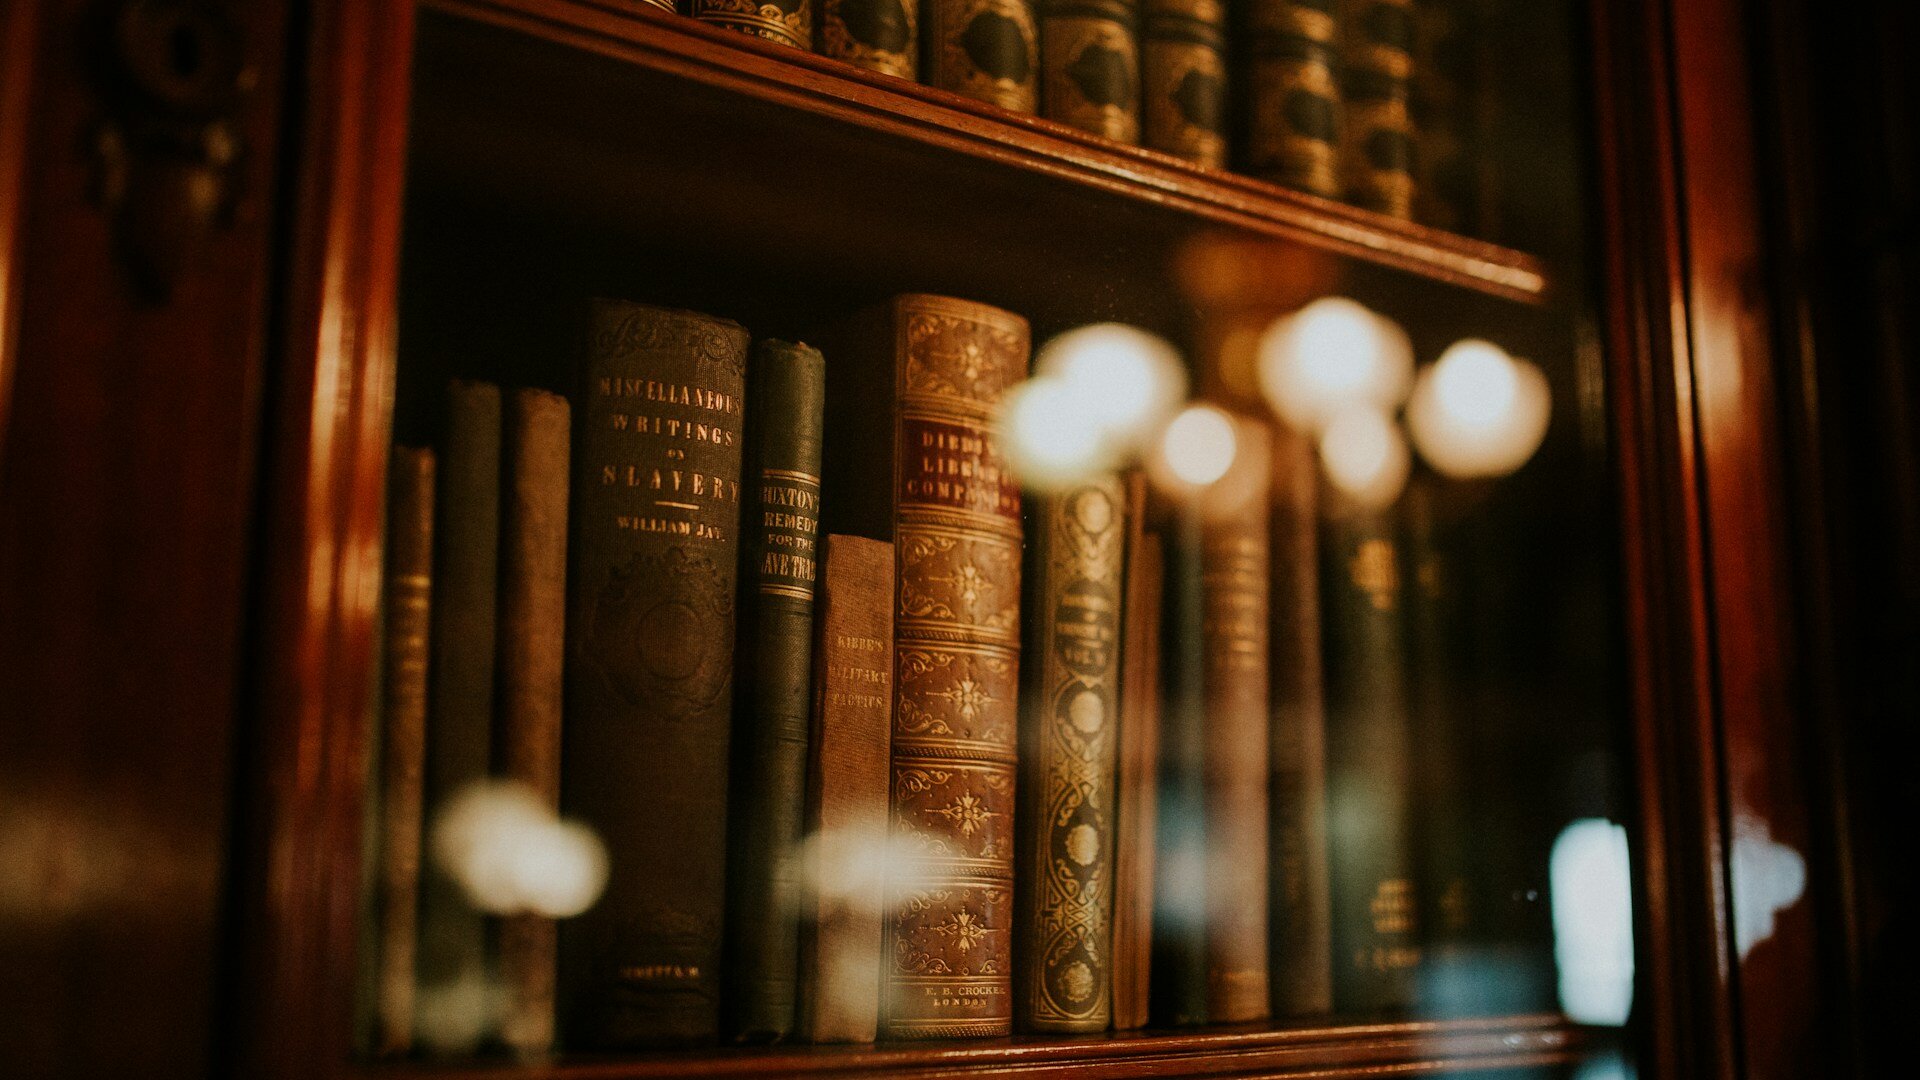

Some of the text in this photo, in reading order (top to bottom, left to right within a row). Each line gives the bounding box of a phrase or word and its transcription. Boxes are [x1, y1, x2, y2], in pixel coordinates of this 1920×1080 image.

[613, 414, 733, 447] WRITINGS
[665, 448, 685, 460] ON
[602, 464, 739, 504] SLAVERY
[616, 515, 691, 537] WILLIAM
[764, 511, 818, 535] REMEDY
[768, 533, 813, 551] FOR THE
[836, 635, 884, 653] KIBBE'S
[933, 998, 987, 1007] LONDON
